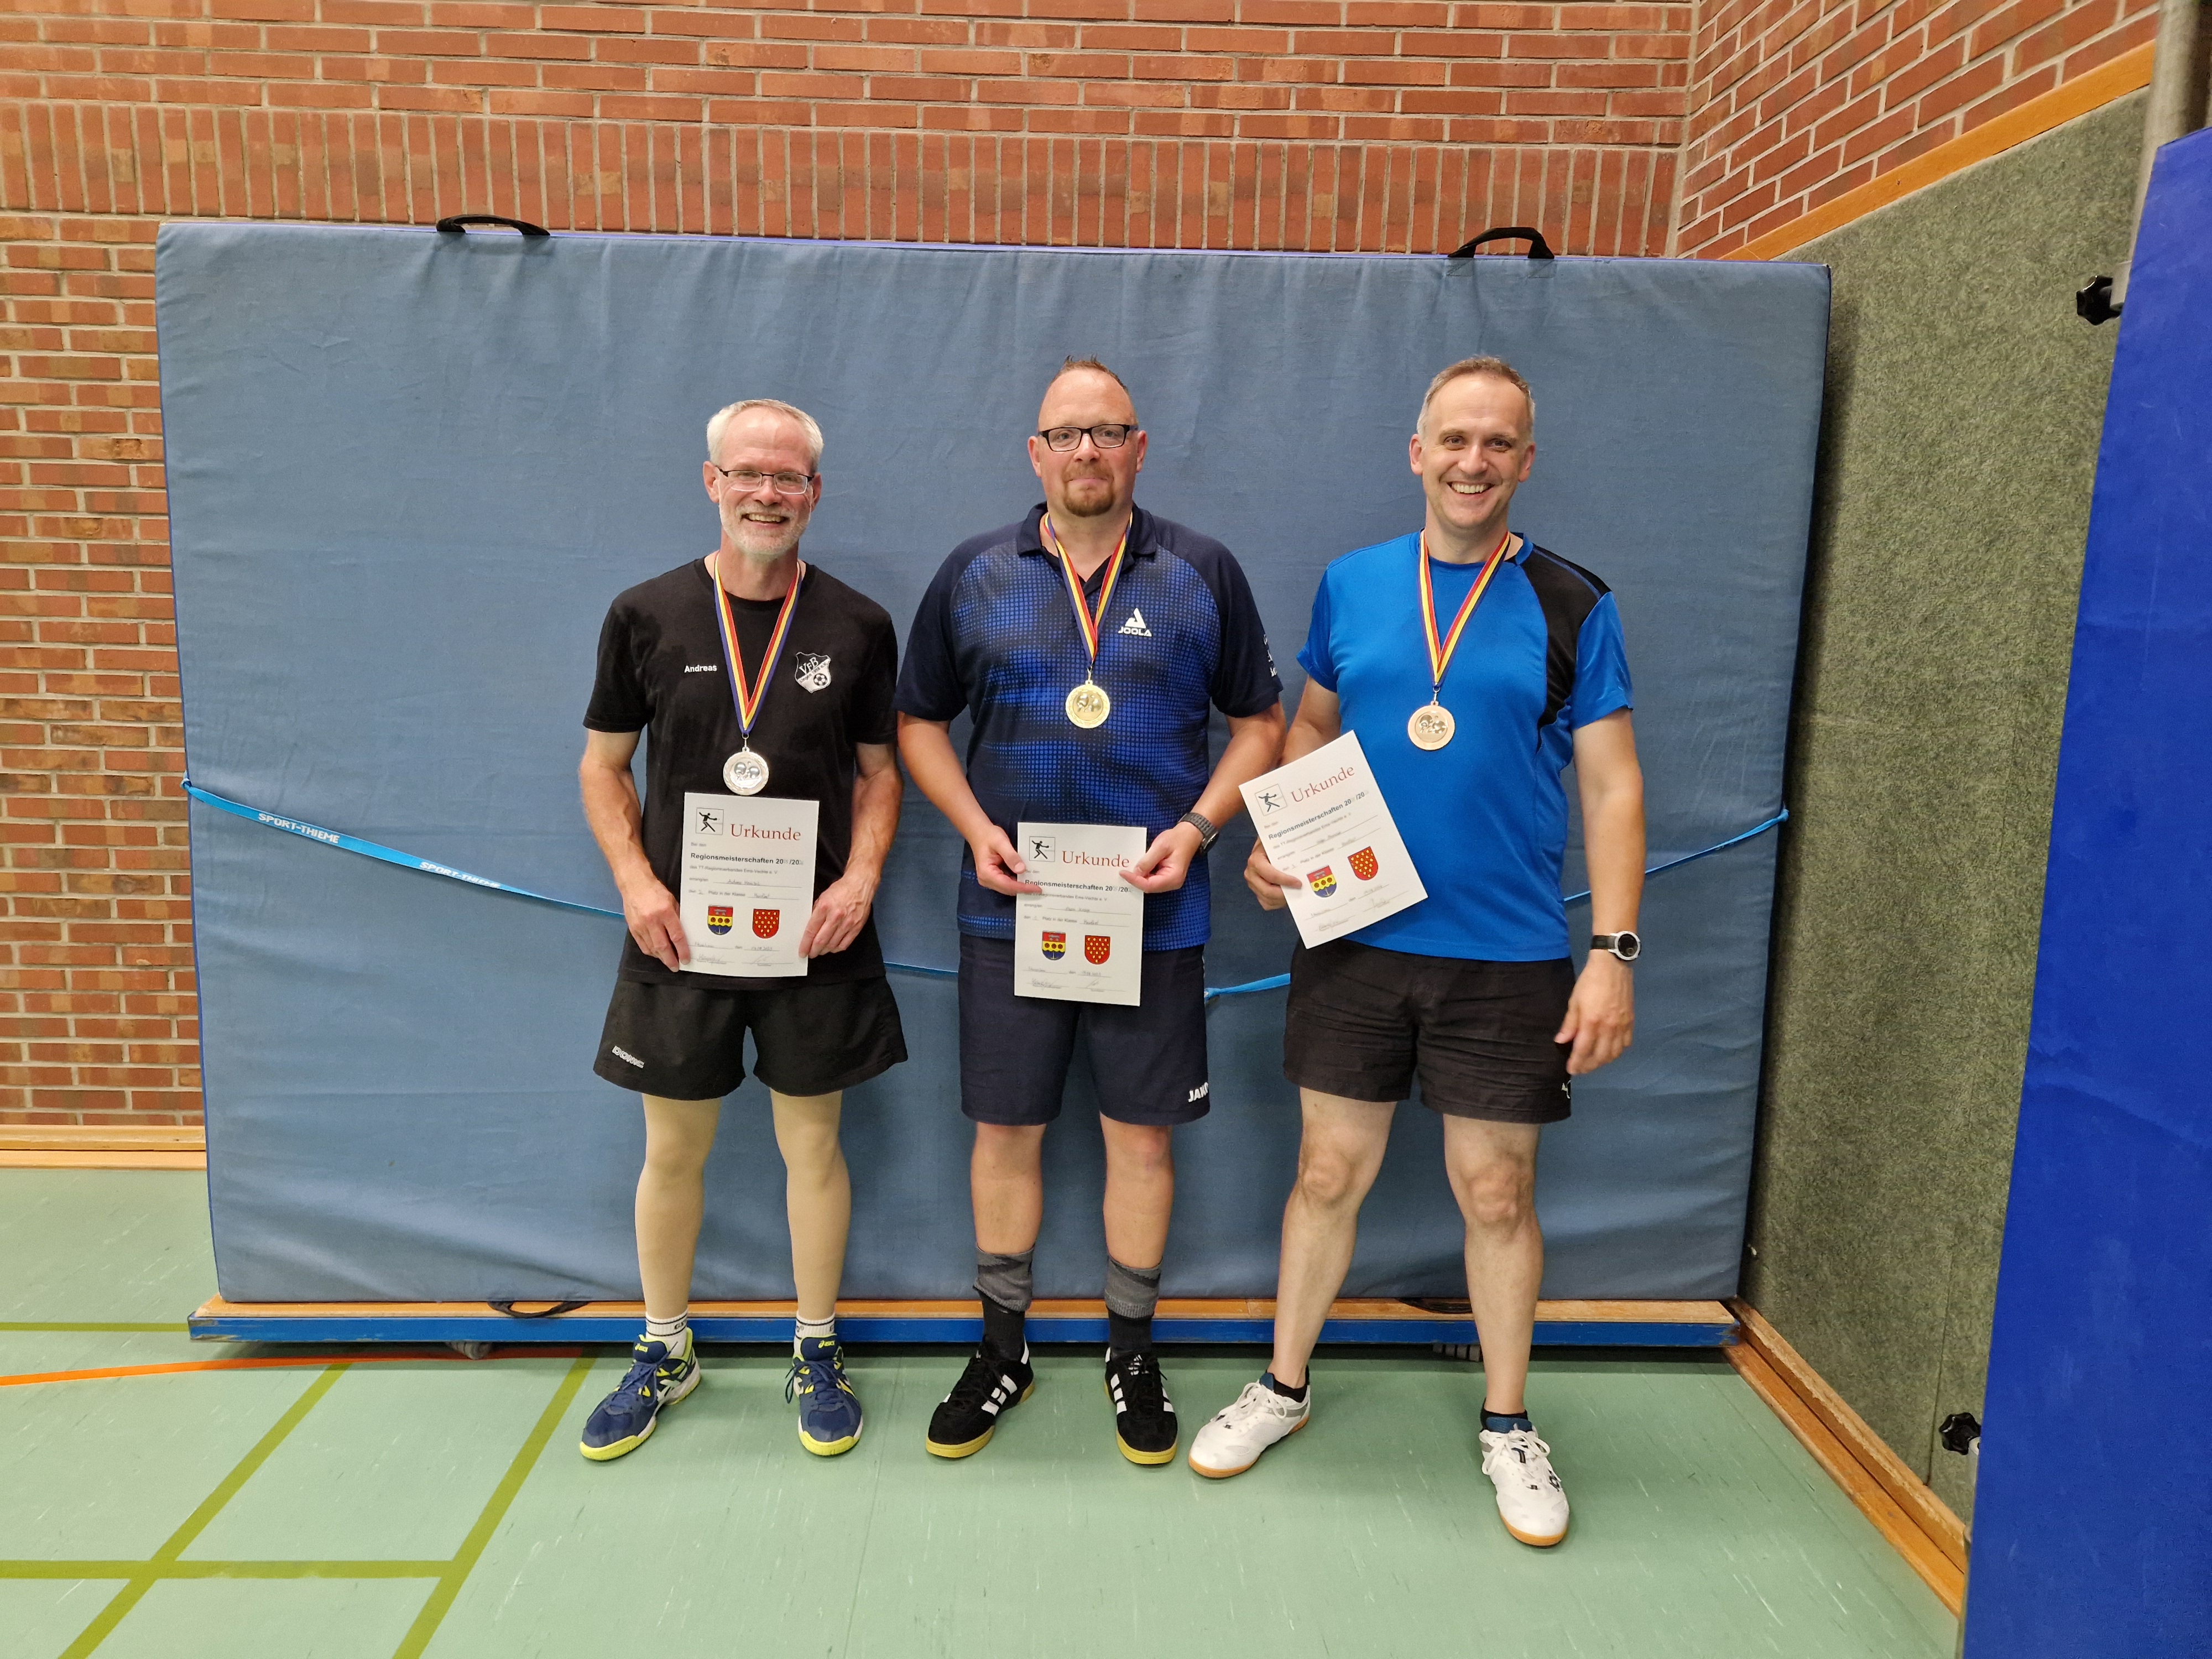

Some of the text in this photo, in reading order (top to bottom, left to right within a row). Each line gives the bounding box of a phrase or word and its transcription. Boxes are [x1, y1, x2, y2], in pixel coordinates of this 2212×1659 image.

[1118, 626, 1152, 637] JOOLA
[684, 665, 717, 673] Andreas
[1290, 766, 1355, 802] Urkunde
[258, 813, 340, 843] SPORT-THIEME
[731, 823, 801, 841] Urkunde
[1269, 804, 1343, 840] Regionsmeisterschaften
[691, 853, 773, 864] Regionsmeisterschaften
[1062, 851, 1129, 867] Urkunde
[420, 862, 500, 889] SPORT-THIEME
[612, 1045, 645, 1068] DONIC
